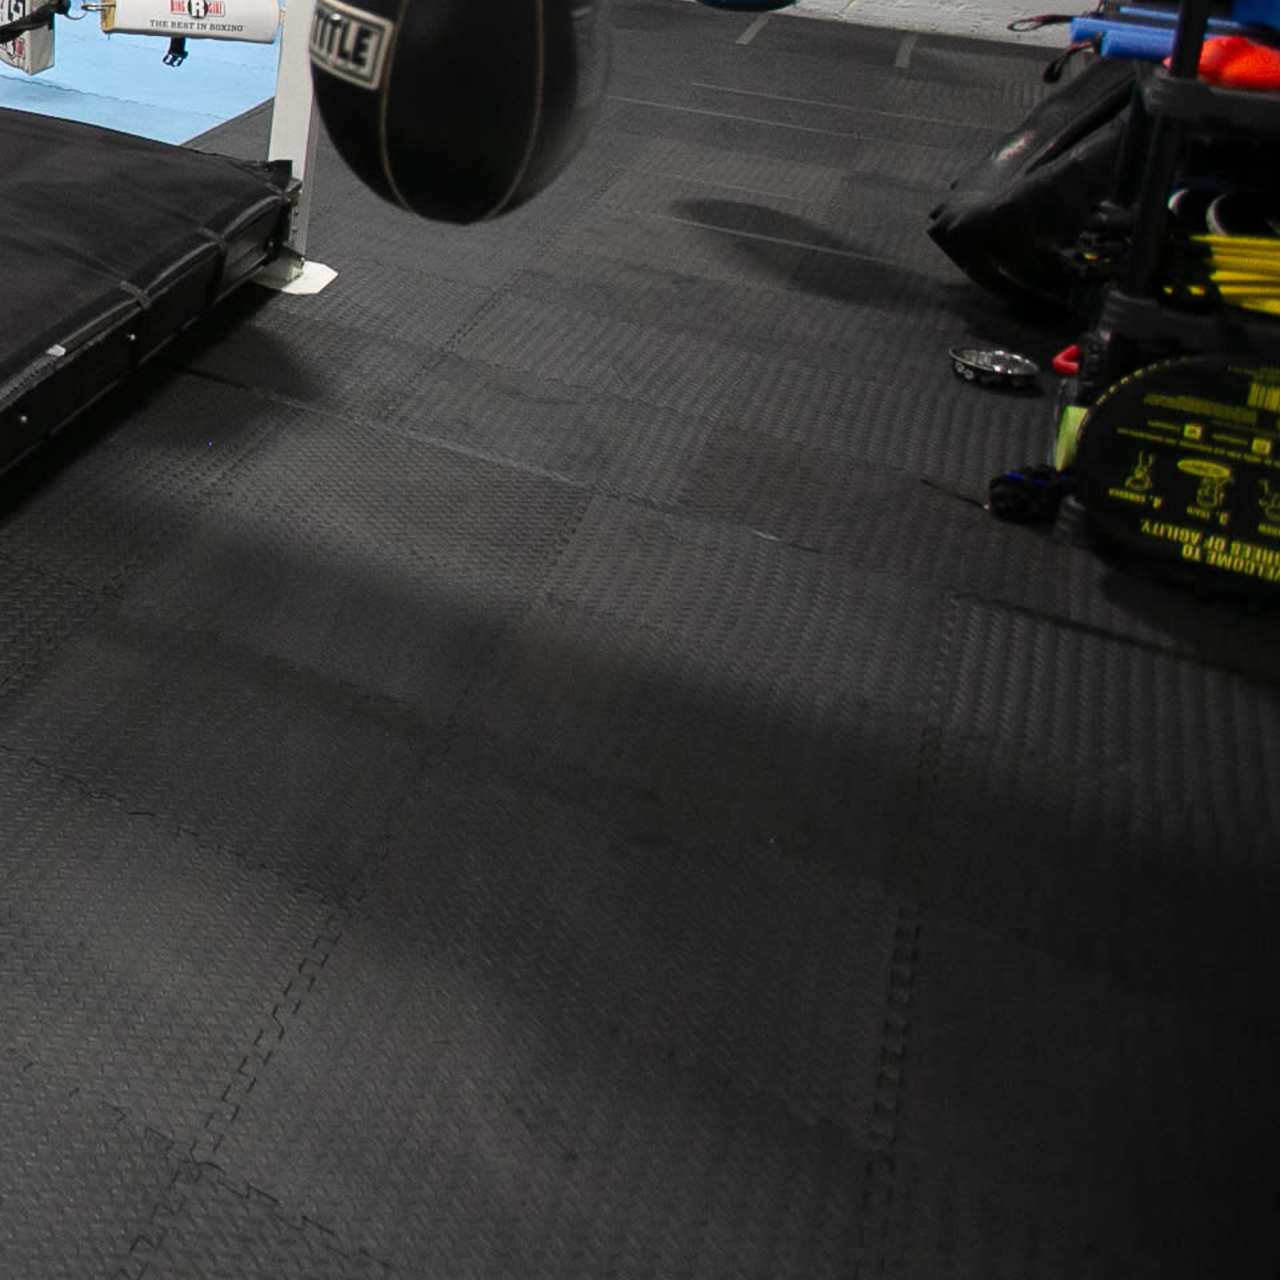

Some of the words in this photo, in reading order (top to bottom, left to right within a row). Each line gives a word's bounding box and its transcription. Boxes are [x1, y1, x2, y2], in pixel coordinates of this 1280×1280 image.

[191, 0, 205, 17] R
[150, 19, 169, 28] THE
[171, 21, 194, 29] BEST
[197, 22, 207, 30] IN
[209, 23, 244, 32] BOXING
